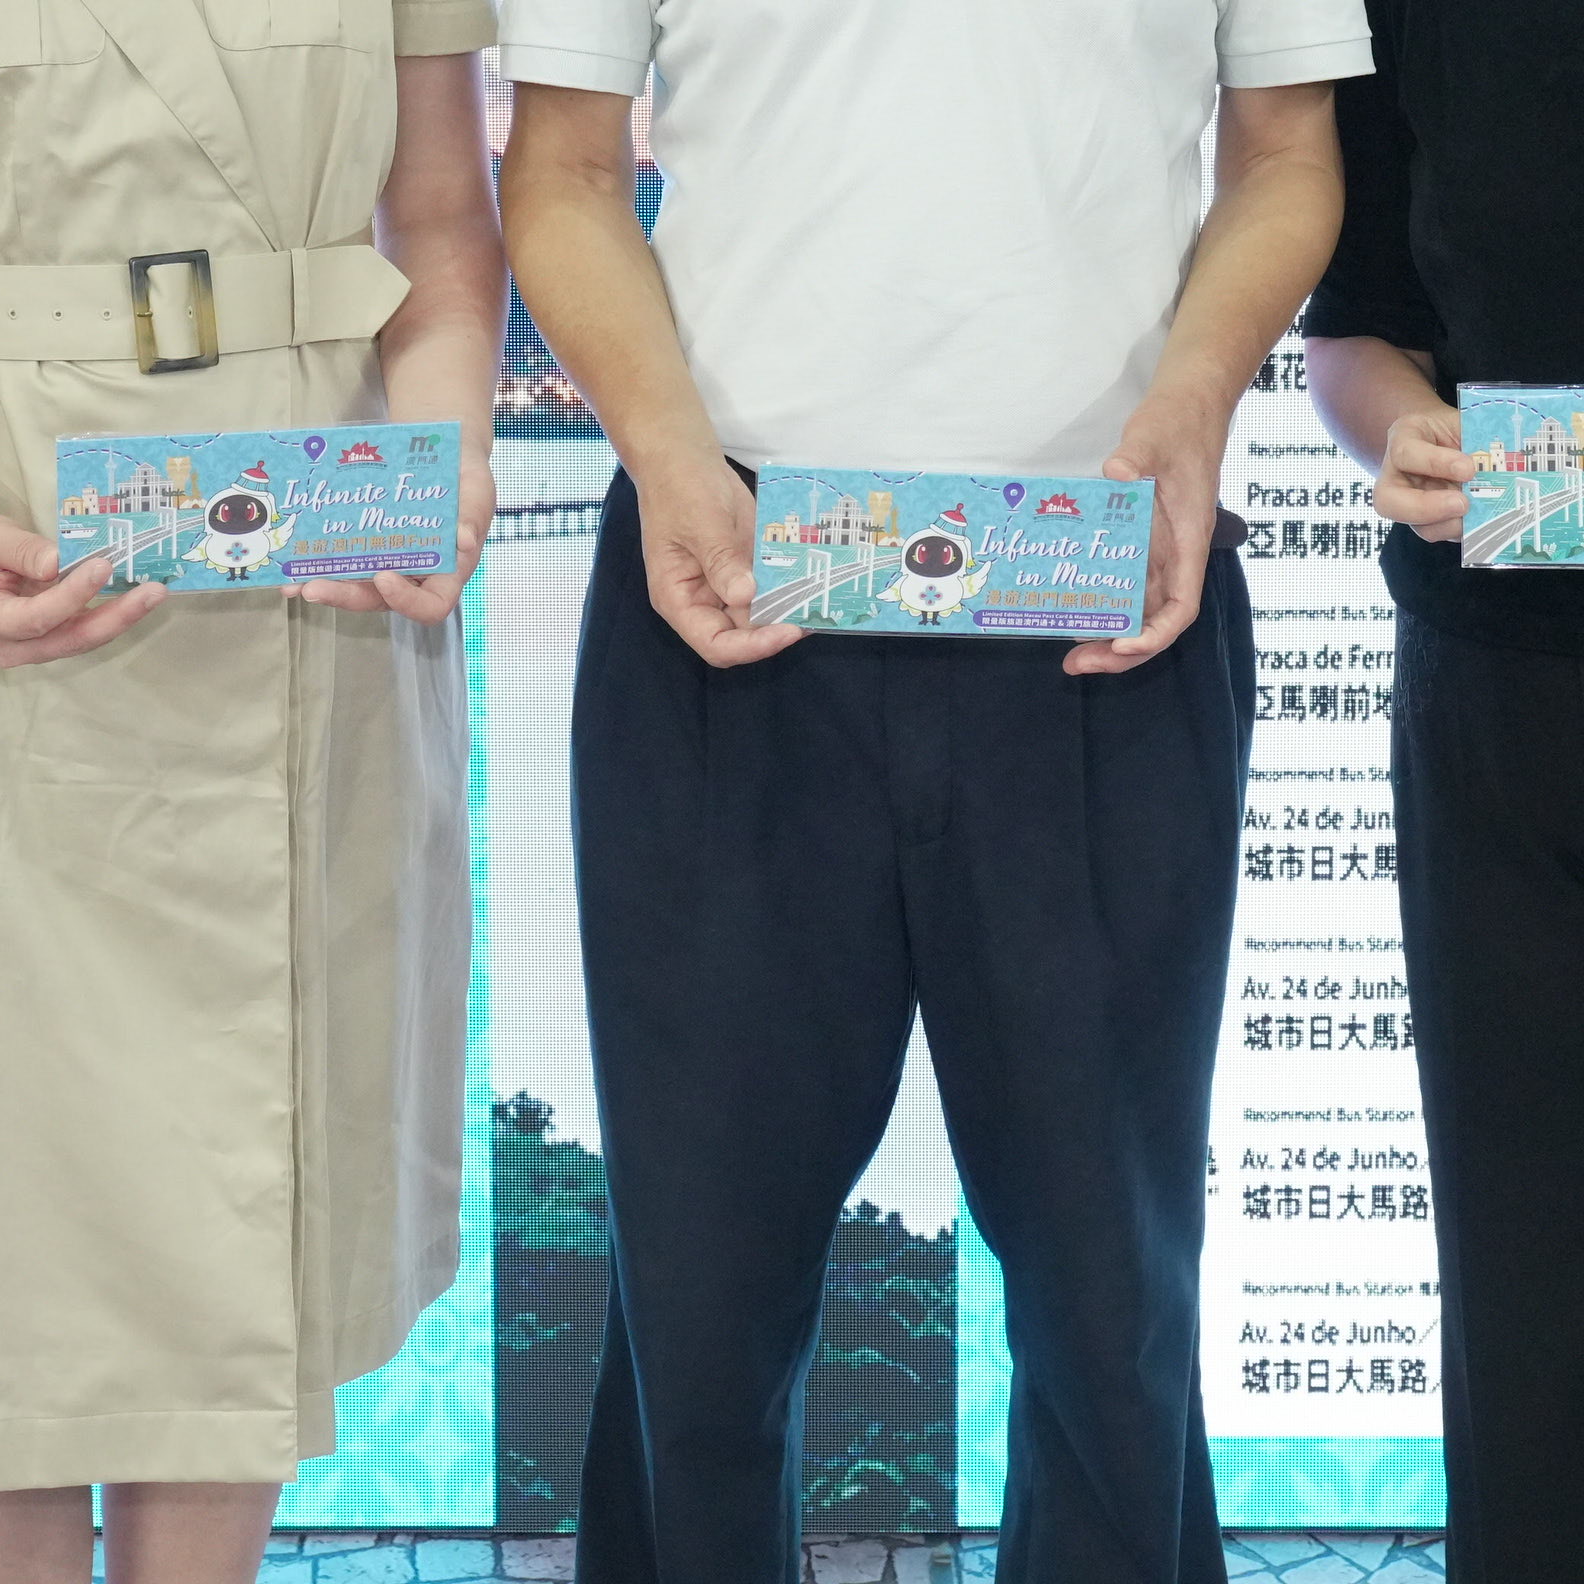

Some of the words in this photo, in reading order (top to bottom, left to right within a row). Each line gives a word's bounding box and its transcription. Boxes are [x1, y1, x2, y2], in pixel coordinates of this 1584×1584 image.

[279, 478, 388, 513] Infinite
[393, 472, 450, 503] Fun
[322, 518, 354, 535] in
[359, 507, 444, 532] Macau
[1241, 975, 1276, 1001] Av.
[1282, 975, 1308, 1000] 24
[1314, 975, 1344, 1000] de
